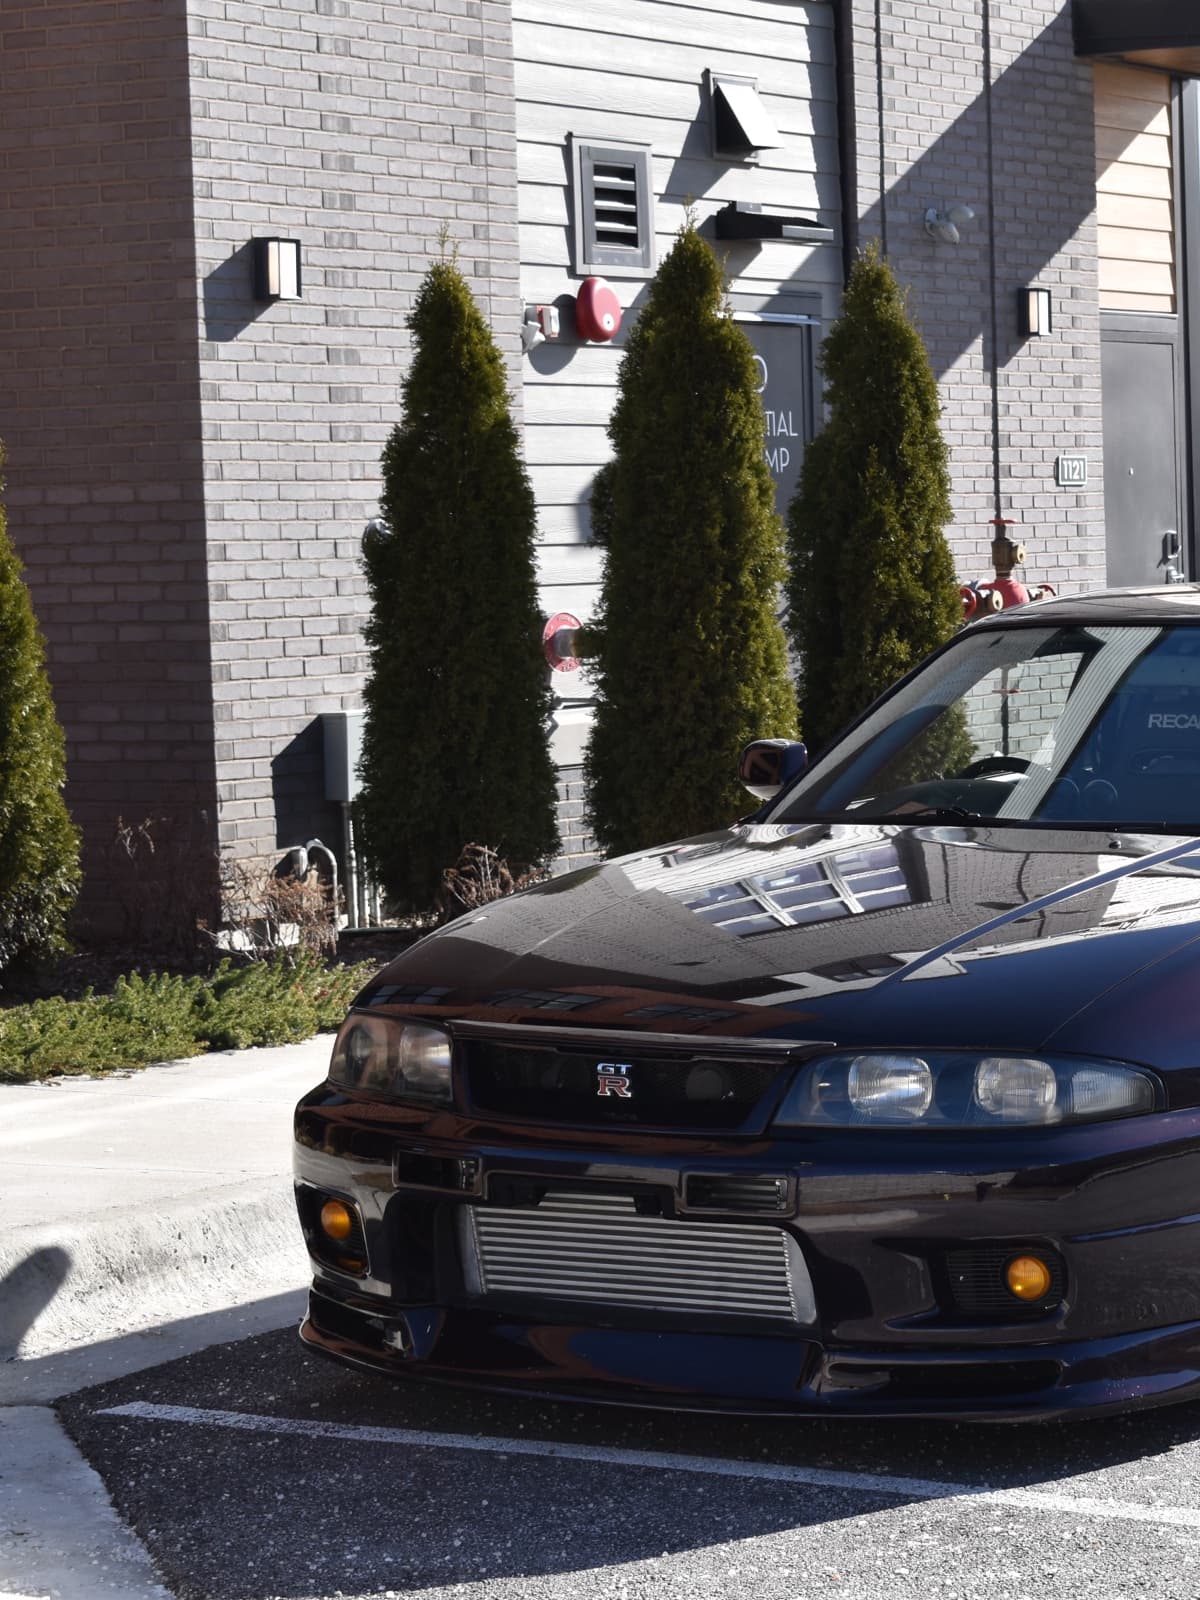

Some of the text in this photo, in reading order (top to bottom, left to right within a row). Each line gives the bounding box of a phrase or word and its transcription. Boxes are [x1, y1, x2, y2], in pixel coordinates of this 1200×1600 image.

[763, 410, 799, 438] TIAL
[765, 447, 790, 473] MP
[1062, 460, 1084, 480] 1121
[596, 1062, 633, 1075] GT
[596, 1074, 633, 1098] R
